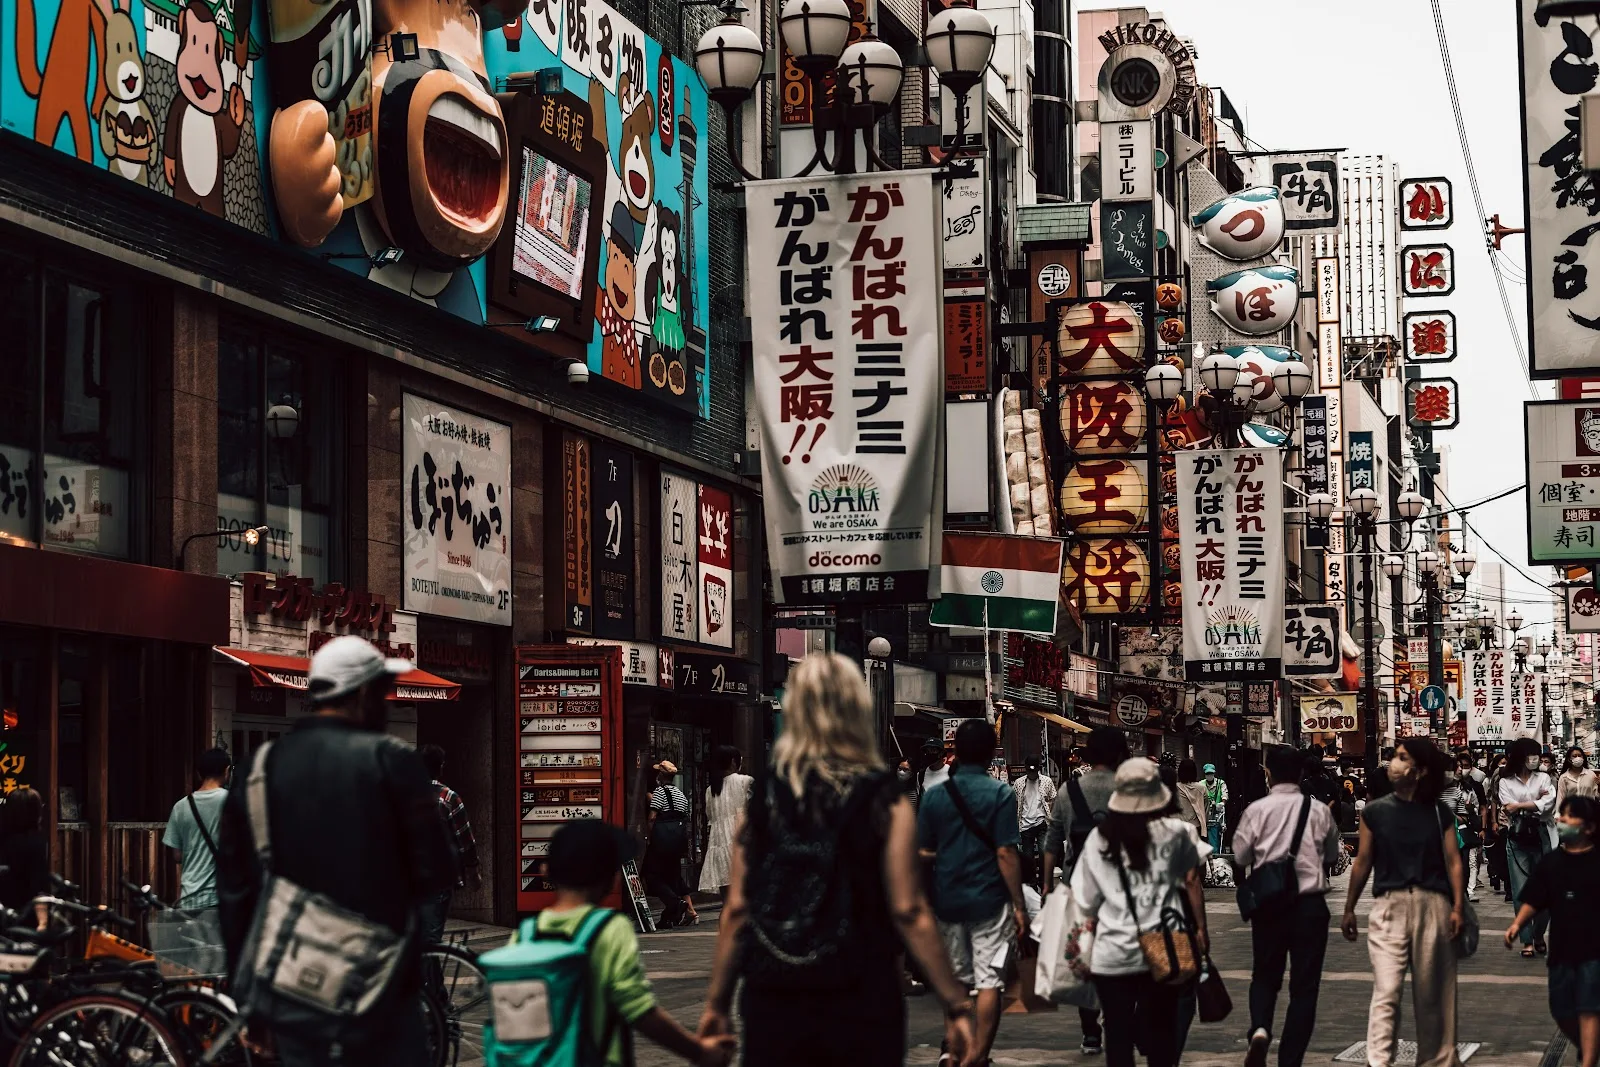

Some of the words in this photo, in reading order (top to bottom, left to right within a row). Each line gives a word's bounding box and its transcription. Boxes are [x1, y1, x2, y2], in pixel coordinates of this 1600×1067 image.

[1120, 72, 1149, 95] NK
[540, 95, 585, 152] 道頓堀
[1281, 175, 1332, 213] 牛角
[847, 182, 908, 454] がんばれミナミ
[1058, 302, 1147, 614] 大阪王将
[1350, 441, 1372, 487] 焼肉
[808, 480, 880, 514] OSAKA
[812, 520, 828, 529] We
[829, 521, 844, 529] are
[846, 519, 878, 528] OSAKA
[1233, 453, 1266, 599] がんばれミナミ
[1553, 526, 1594, 549] 寿司
[447, 551, 460, 565] Since
[460, 553, 472, 568] 1946
[672, 498, 693, 634] 白木屋
[808, 551, 881, 568] docomo
[802, 575, 895, 594] 道頓堀商店会
[497, 589, 509, 611] 2F
[573, 606, 583, 626] 3F
[1204, 621, 1262, 646] OSAKA
[1285, 620, 1333, 659] 牛角
[1234, 650, 1261, 658] OSAKA
[534, 668, 580, 678] Darts&Dining
[580, 667, 593, 677] Bar
[682, 663, 699, 687] 7F
[1490, 651, 1505, 715] がんばれミナミ
[523, 791, 534, 799] 3F
